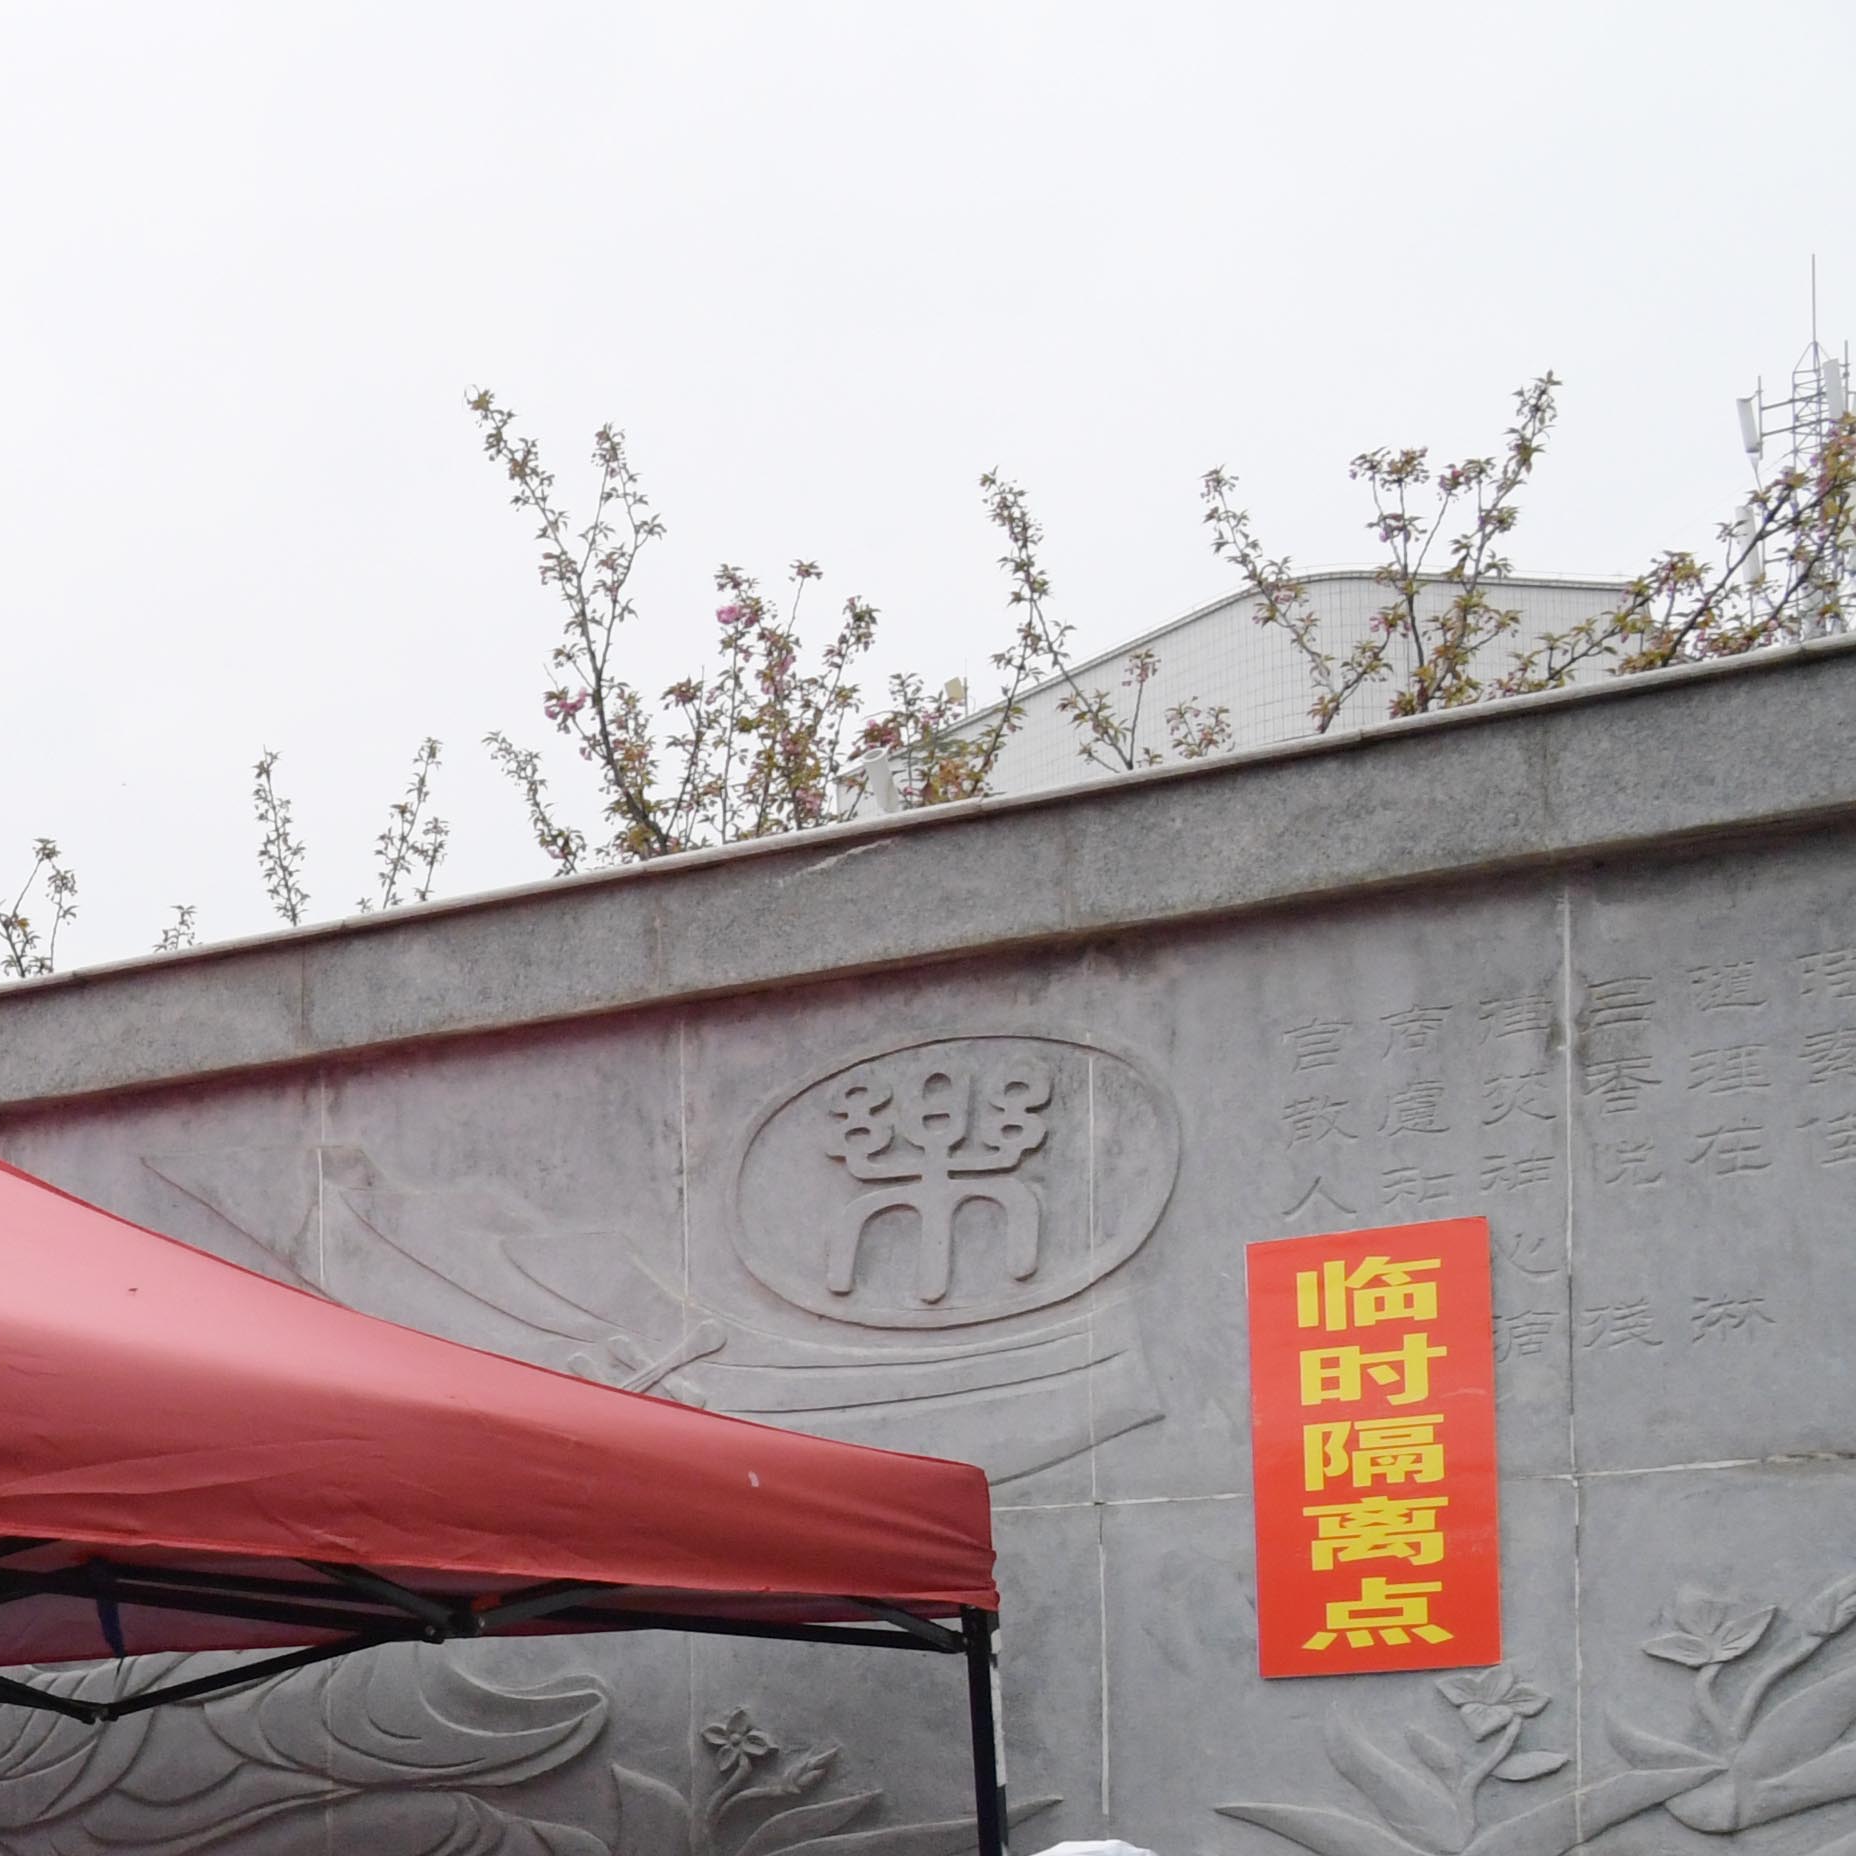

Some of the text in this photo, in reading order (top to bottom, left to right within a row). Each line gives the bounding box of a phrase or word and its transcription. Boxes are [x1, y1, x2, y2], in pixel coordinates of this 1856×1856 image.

[1296, 1255, 1455, 1651] 临时隔离点
